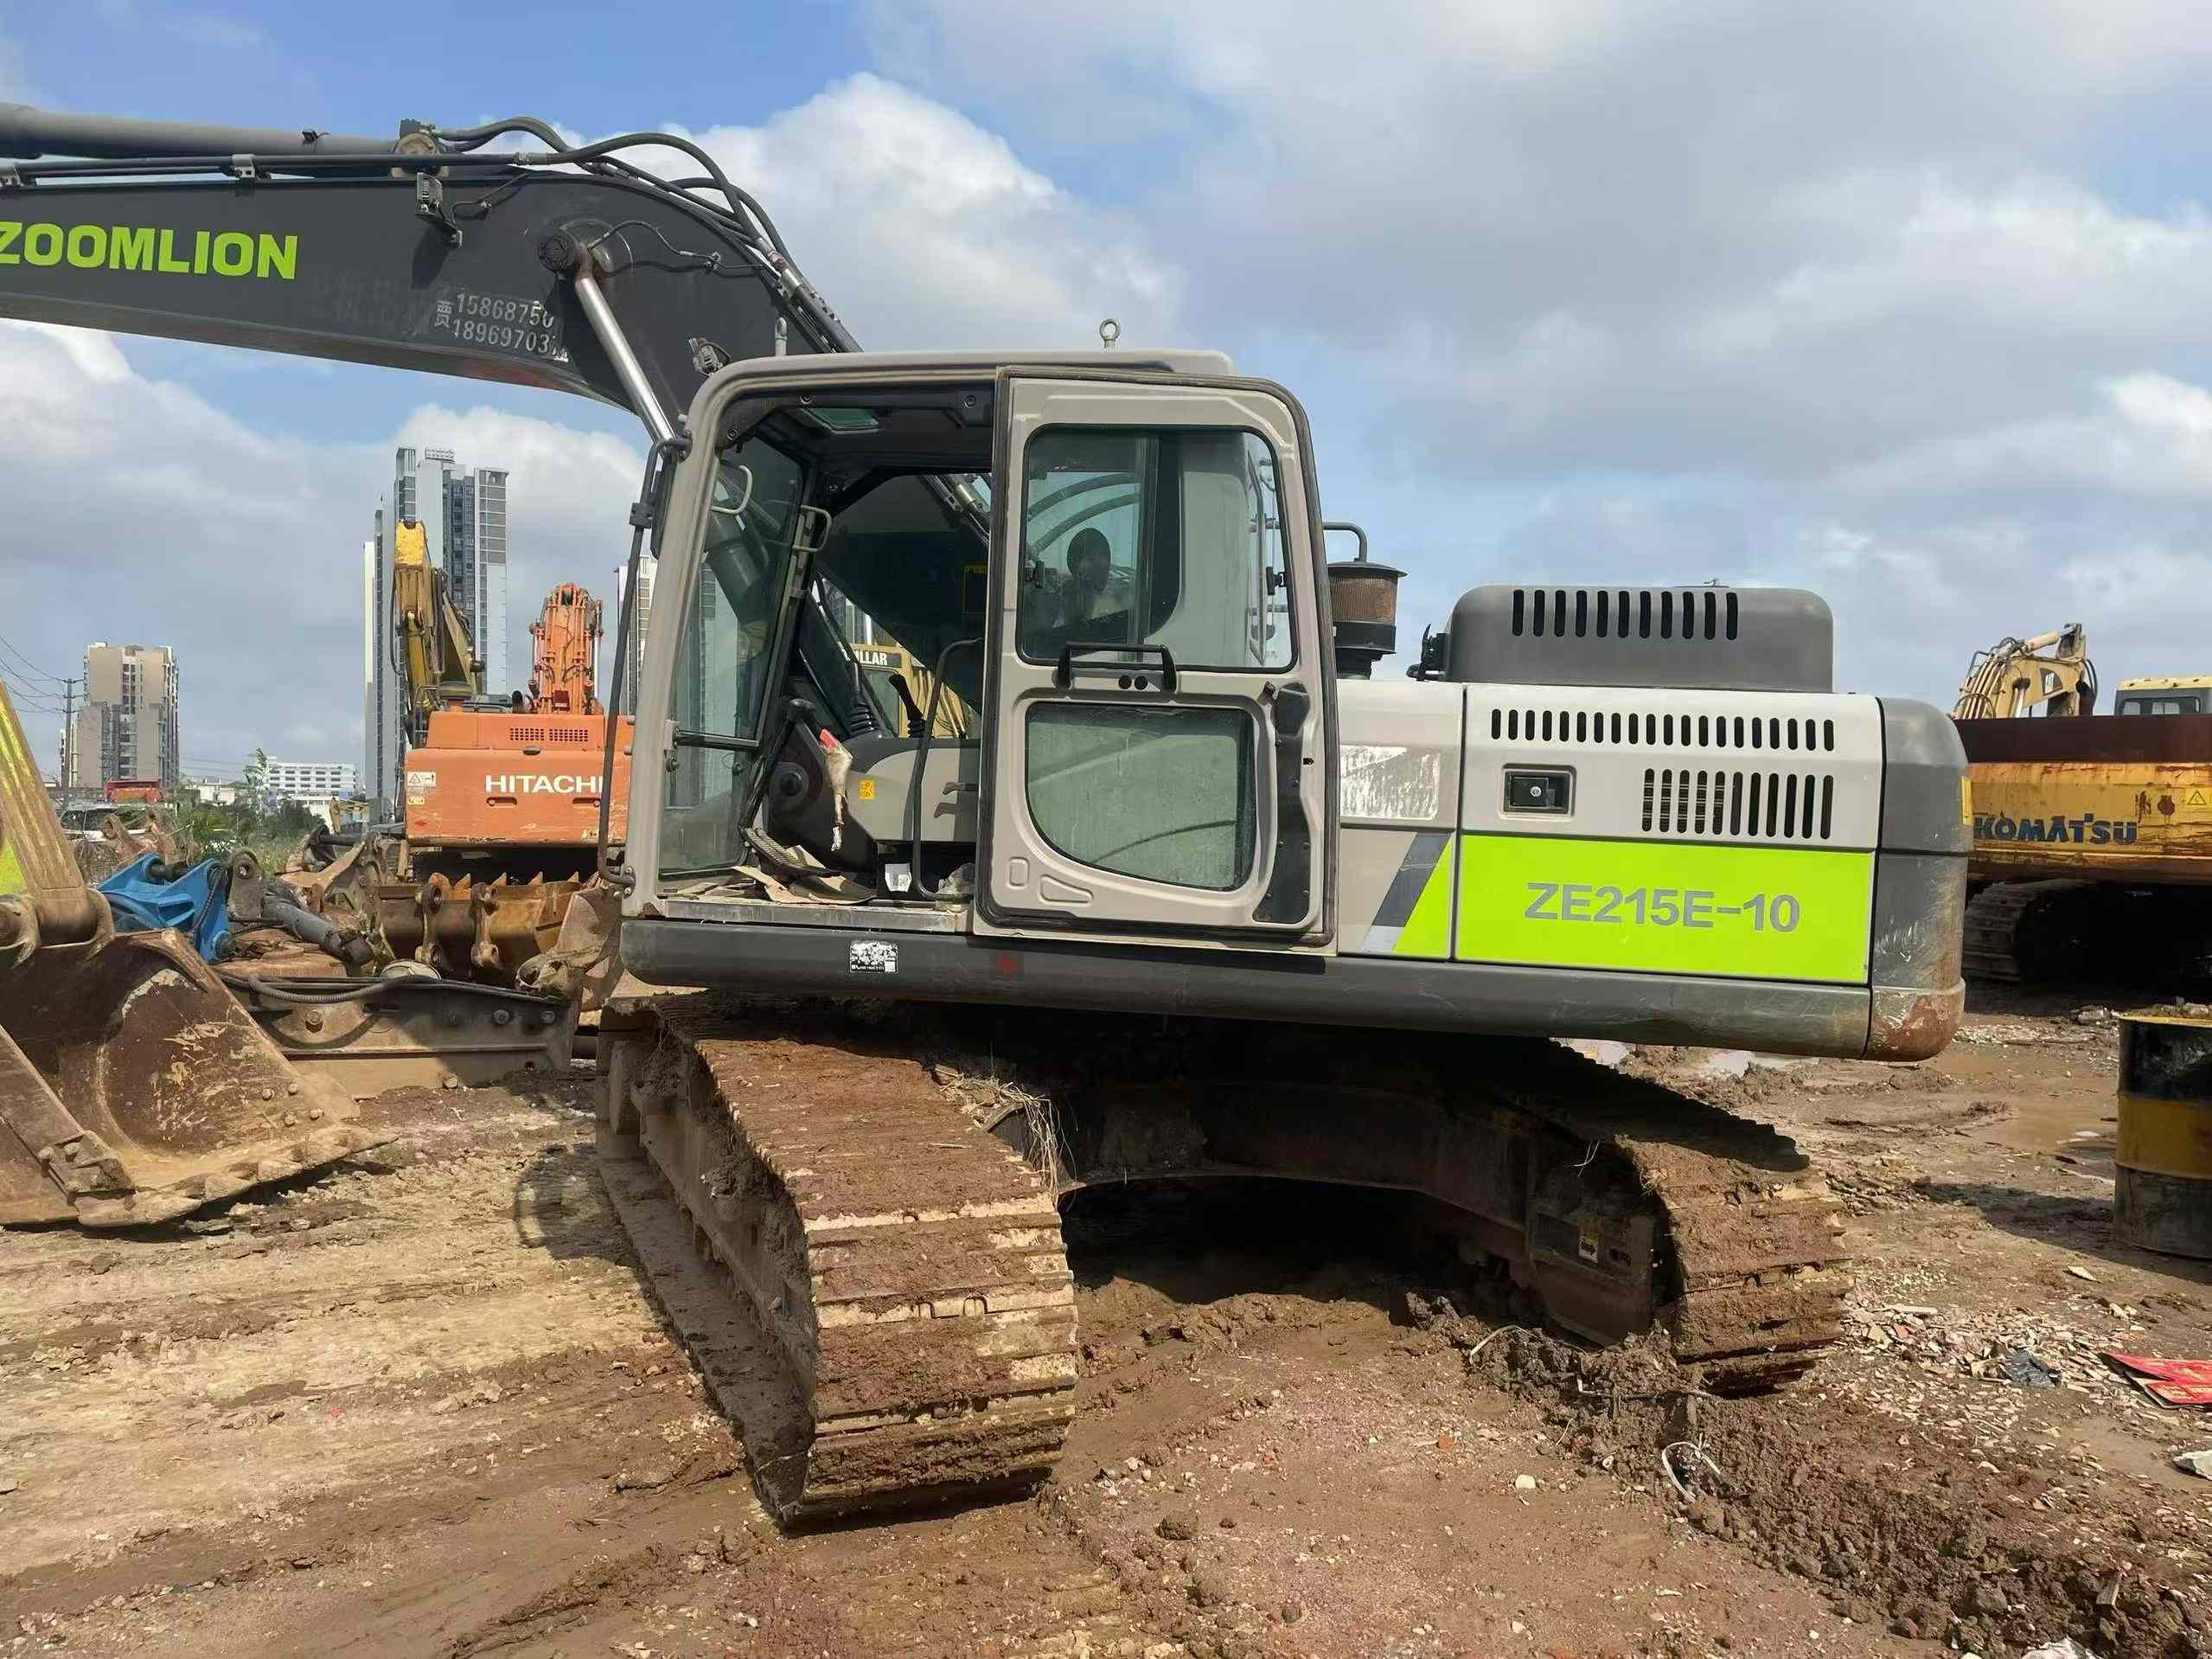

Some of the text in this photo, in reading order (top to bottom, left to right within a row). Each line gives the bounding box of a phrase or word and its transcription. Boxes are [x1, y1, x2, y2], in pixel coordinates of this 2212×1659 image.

[0, 221, 298, 280] ZOOMLION
[485, 775, 604, 793] HITACHI
[1973, 812, 2138, 845] KOMATSU
[1524, 881, 1800, 932] ZE215E-10
